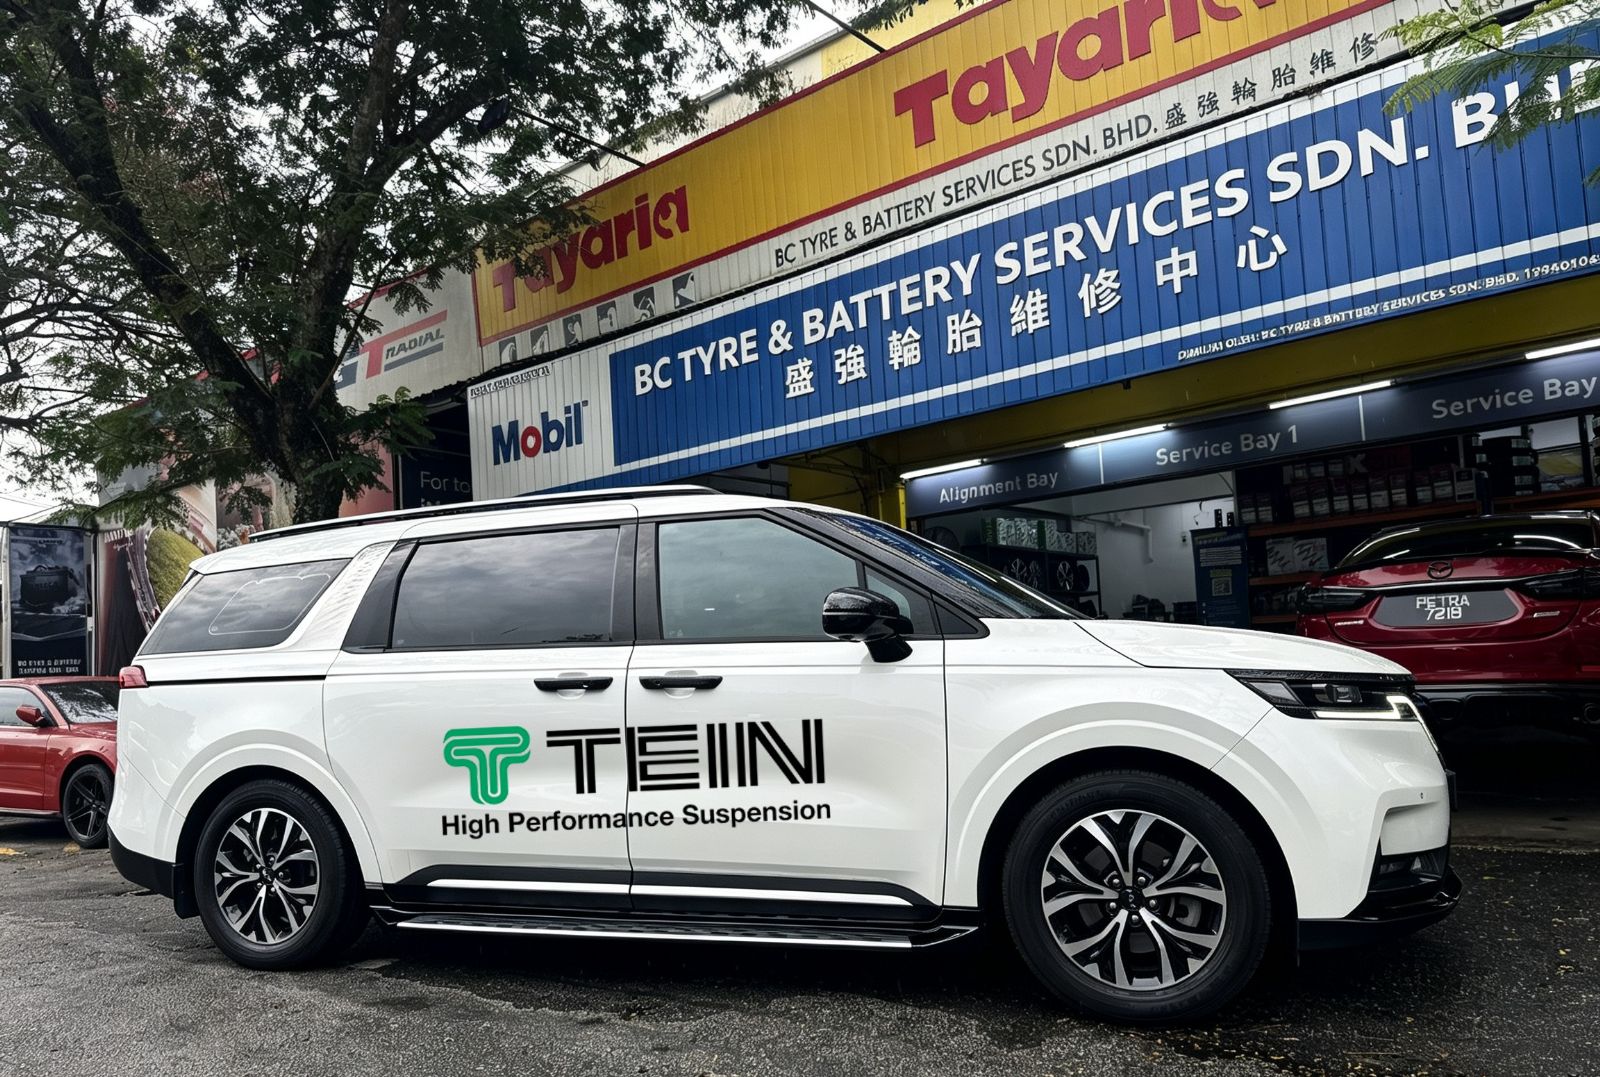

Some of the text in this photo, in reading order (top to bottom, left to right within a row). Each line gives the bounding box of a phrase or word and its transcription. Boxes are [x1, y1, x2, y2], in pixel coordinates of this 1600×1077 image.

[775, 114, 1158, 267] BC TYRE & BATTERY SERVICES SDN. BHD.
[634, 357, 672, 397] BC
[677, 327, 760, 381] TYRE
[768, 319, 793, 353] &
[802, 253, 981, 345] BATTERY
[995, 168, 1249, 285] SERVICES
[1266, 118, 1430, 203] SDN.
[785, 225, 1287, 399] 盛強輪胎維修中心
[1431, 376, 1598, 419] Service Bay
[492, 401, 583, 466] Mobil
[1155, 425, 1299, 466] Service Bay 1
[420, 470, 449, 492] For
[939, 471, 1058, 504] Alignment Bay
[1416, 594, 1470, 610] PETRA
[1424, 606, 1462, 621] 7218
[441, 800, 831, 839] High Performance Suspension
